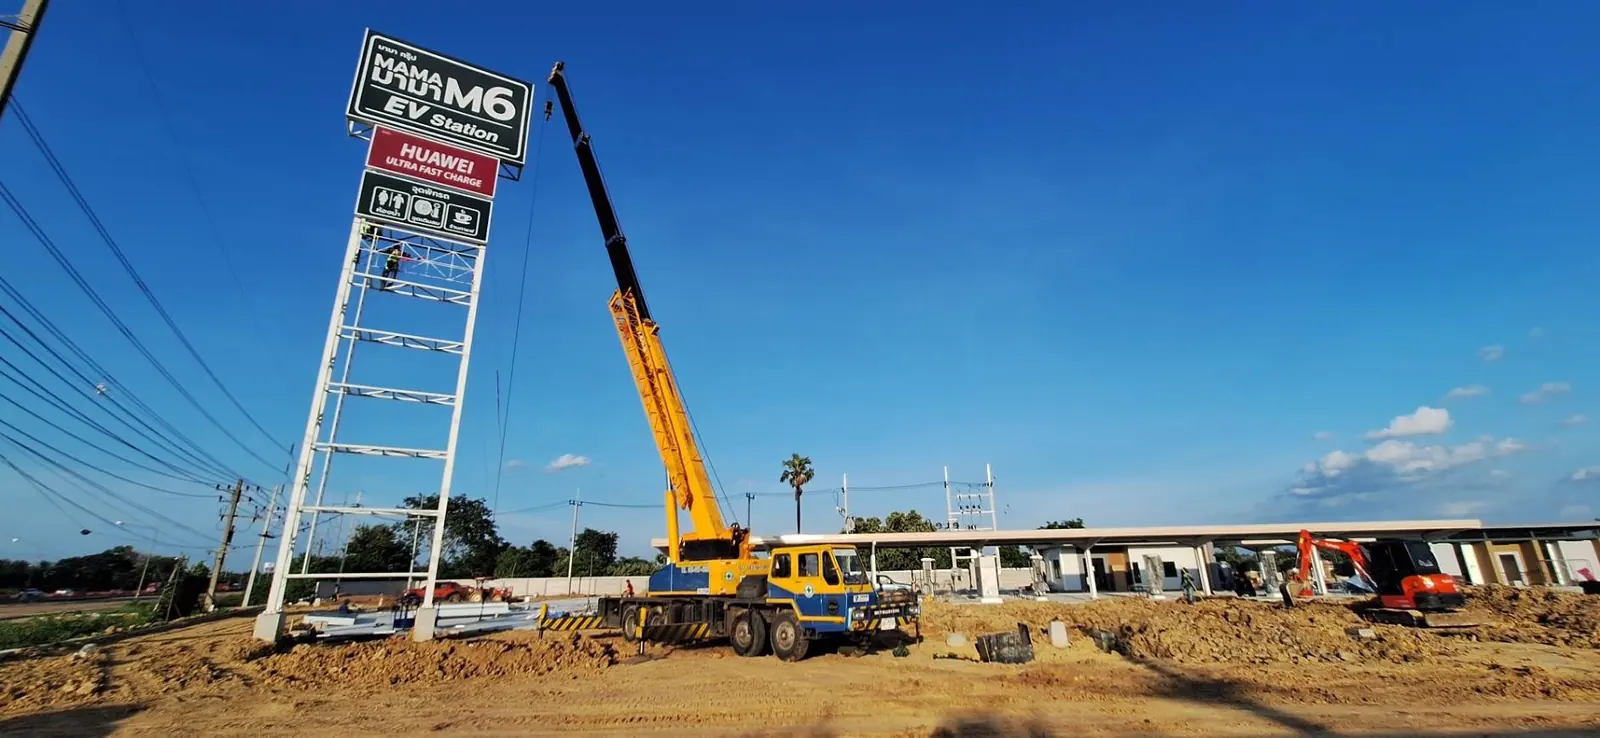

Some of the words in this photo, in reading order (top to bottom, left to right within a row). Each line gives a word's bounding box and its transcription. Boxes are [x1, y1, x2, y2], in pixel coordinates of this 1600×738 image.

[378, 44, 398, 56] มามา
[371, 65, 442, 101] มามา
[374, 53, 443, 88] MAMA
[443, 76, 516, 121] M6
[383, 95, 431, 120] EV
[429, 113, 499, 143] Station
[385, 156, 418, 171] ULTRA
[419, 164, 444, 177] FAST
[443, 171, 483, 188] CHARGE
[400, 143, 475, 174] HUAWEI
